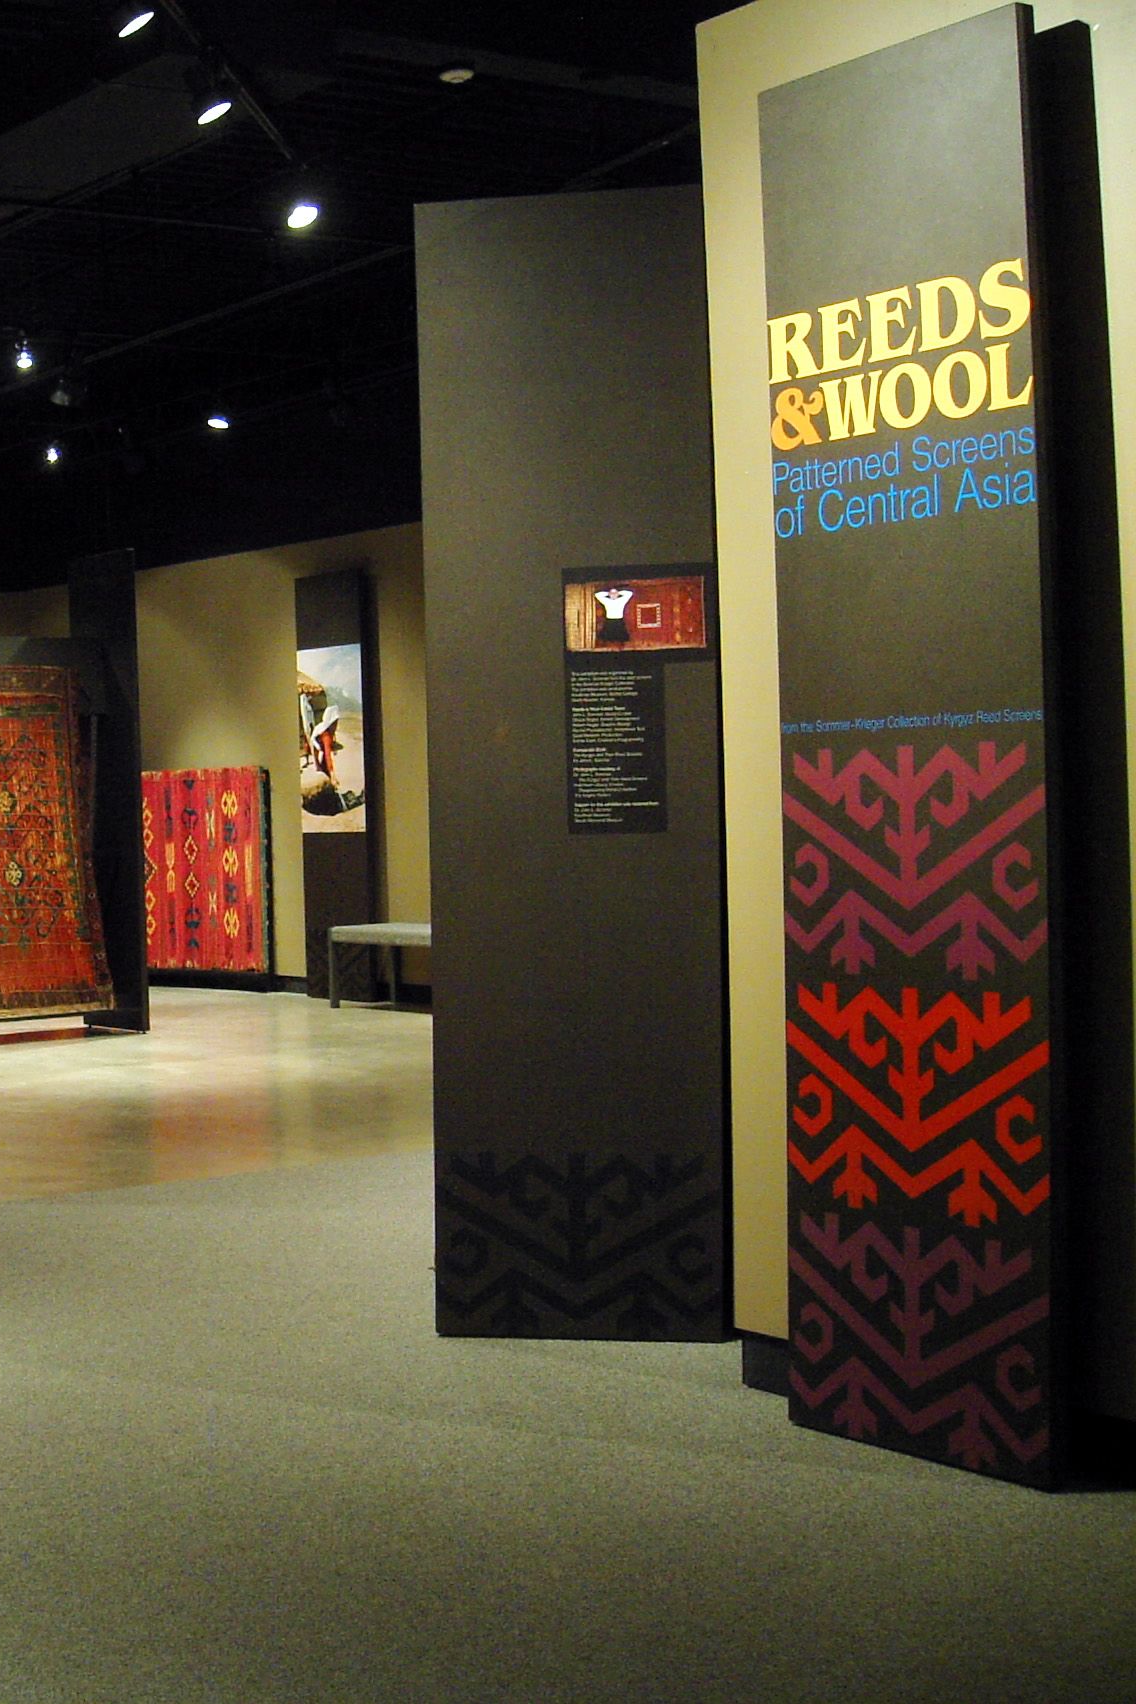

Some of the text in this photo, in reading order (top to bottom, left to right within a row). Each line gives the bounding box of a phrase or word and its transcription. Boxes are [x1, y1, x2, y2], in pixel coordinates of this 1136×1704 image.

[766, 258, 1031, 385] REEDS
[819, 342, 1034, 442] WOOL
[772, 425, 1037, 495] Patterned Screens
[775, 461, 1037, 539] of Central Asia
